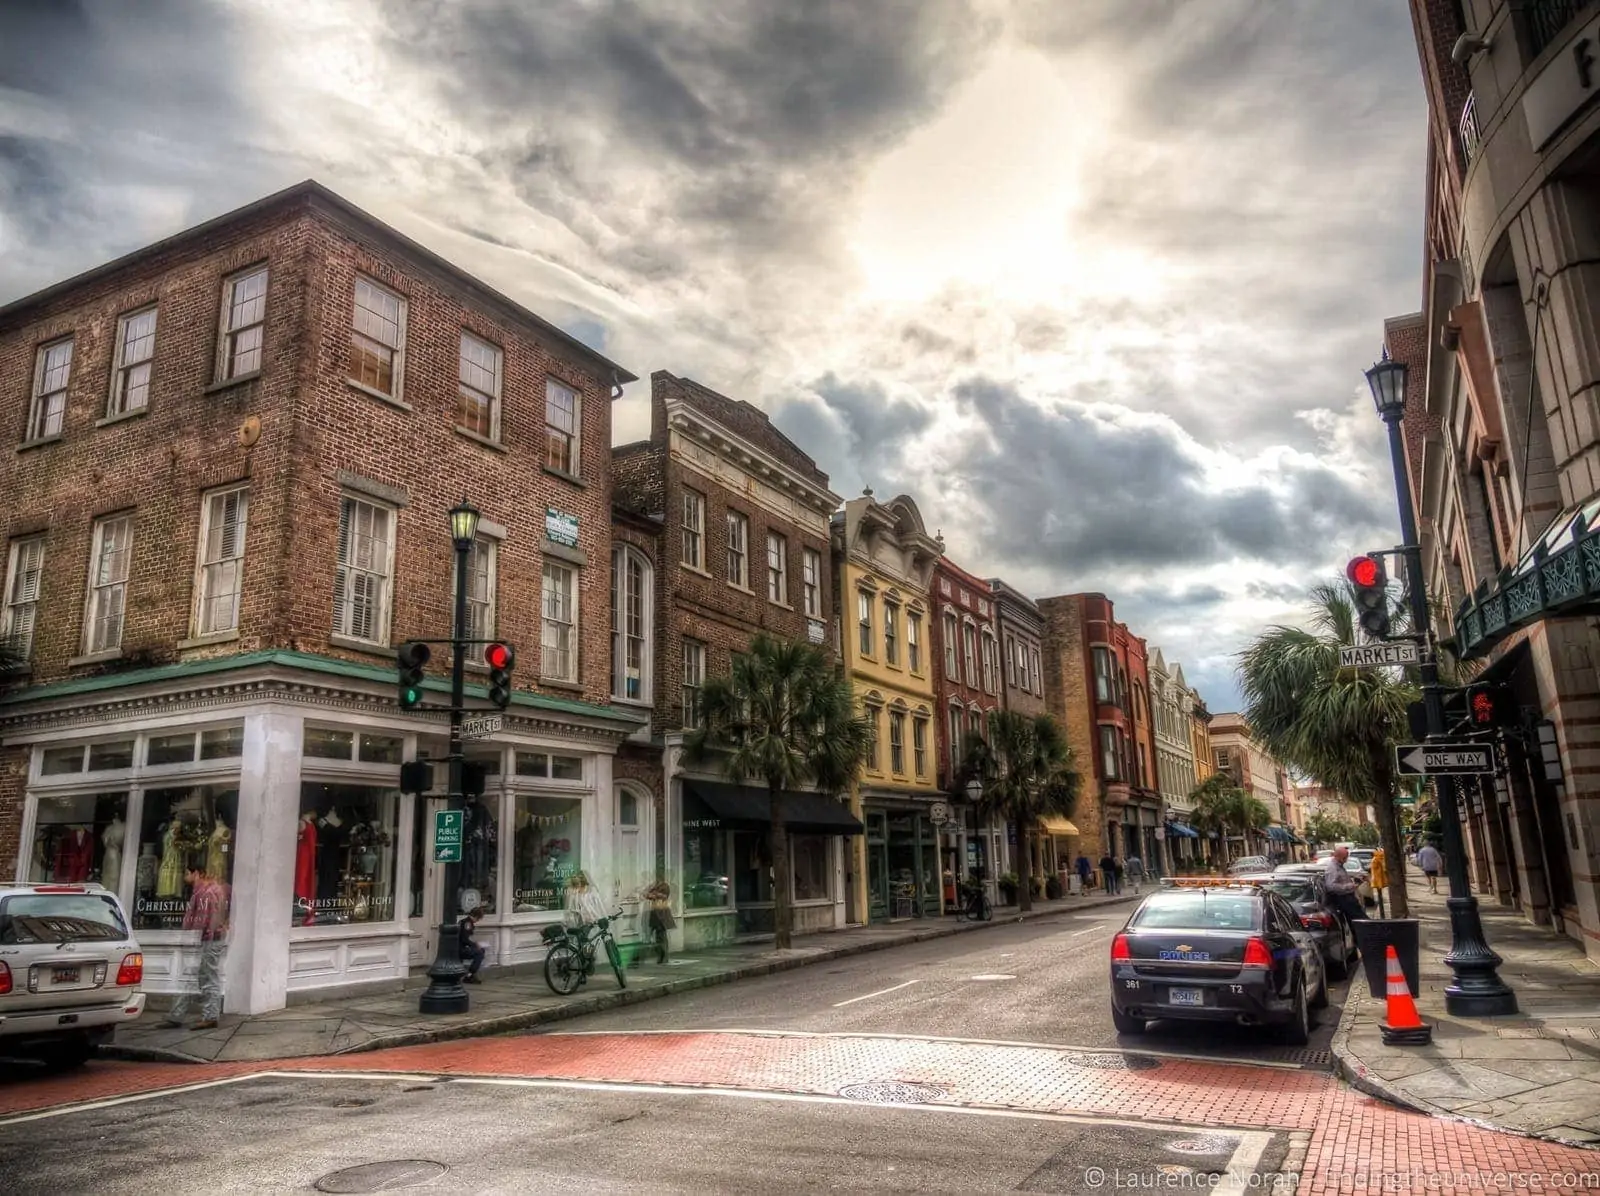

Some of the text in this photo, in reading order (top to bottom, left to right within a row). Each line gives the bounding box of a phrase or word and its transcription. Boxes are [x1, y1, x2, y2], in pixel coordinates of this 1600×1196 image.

[1341, 646, 1413, 665] MARKET ST
[462, 719, 494, 737] MARKET
[1425, 753, 1482, 766] ONE WAY
[445, 814, 454, 826] P
[702, 819, 720, 827] WEST
[438, 827, 459, 835] PUBLIC
[1159, 950, 1210, 961] POLICE
[1126, 980, 1140, 989] 361
[1230, 984, 1243, 994] T2
